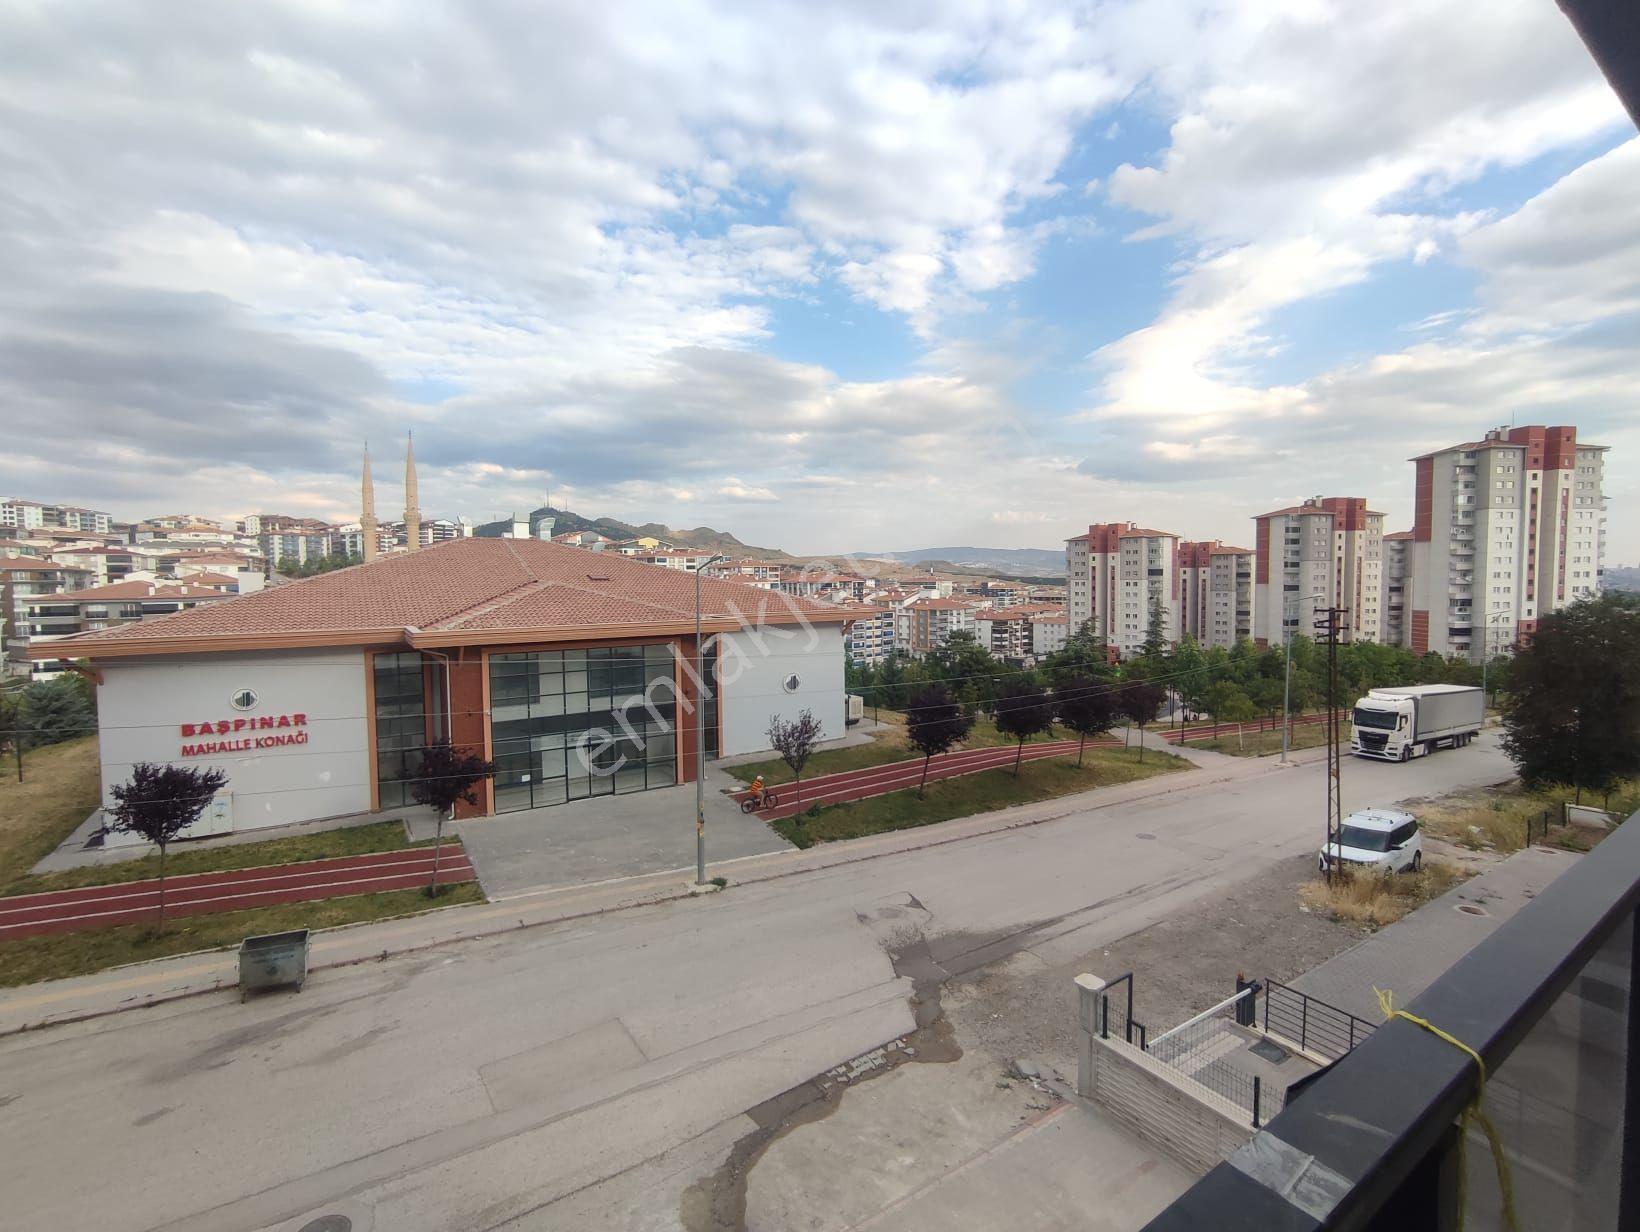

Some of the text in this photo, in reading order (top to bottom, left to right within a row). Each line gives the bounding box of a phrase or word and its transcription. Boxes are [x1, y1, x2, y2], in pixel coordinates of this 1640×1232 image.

[181, 713, 307, 737] BAŞPINAR
[181, 730, 308, 757] MAHALLE KONAĞI
